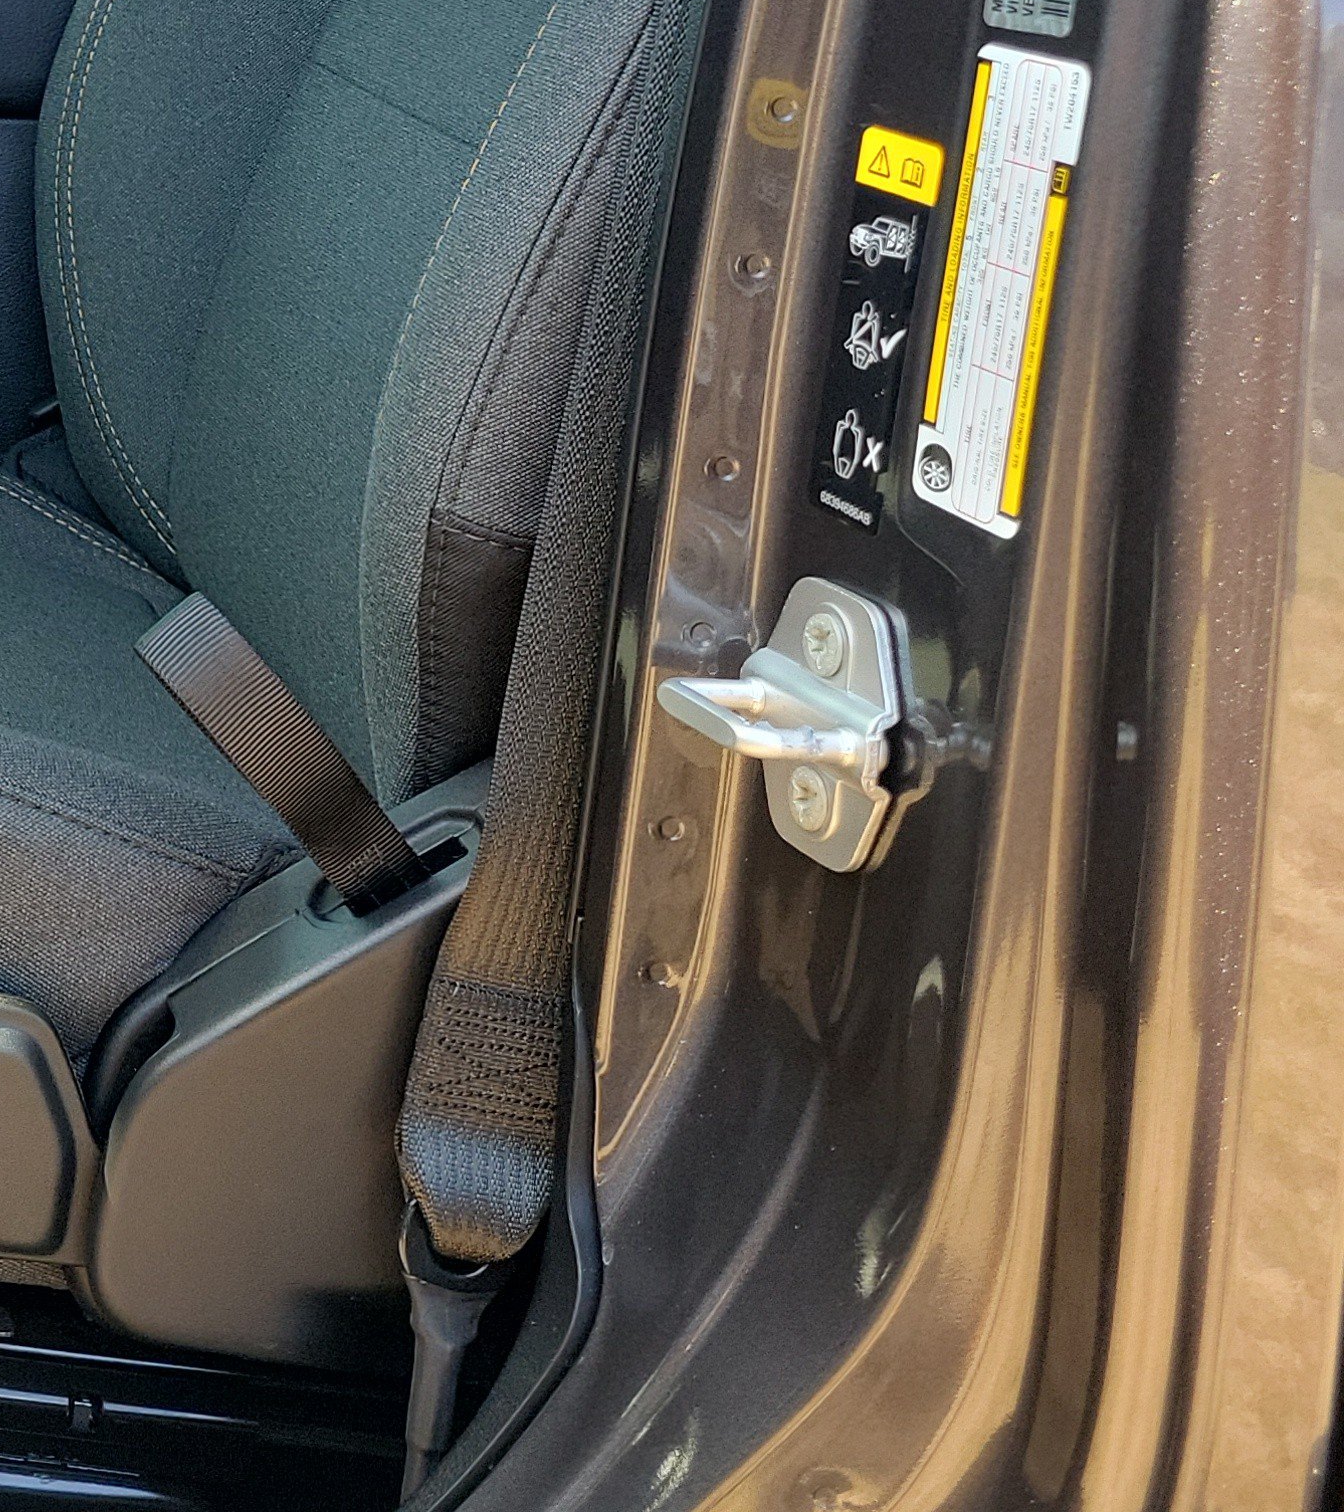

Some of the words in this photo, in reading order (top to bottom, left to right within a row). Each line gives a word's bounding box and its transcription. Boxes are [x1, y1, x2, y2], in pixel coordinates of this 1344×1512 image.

[956, 152, 974, 224] INFORMATION
[948, 225, 962, 272] LOADING
[944, 274, 954, 297] AND
